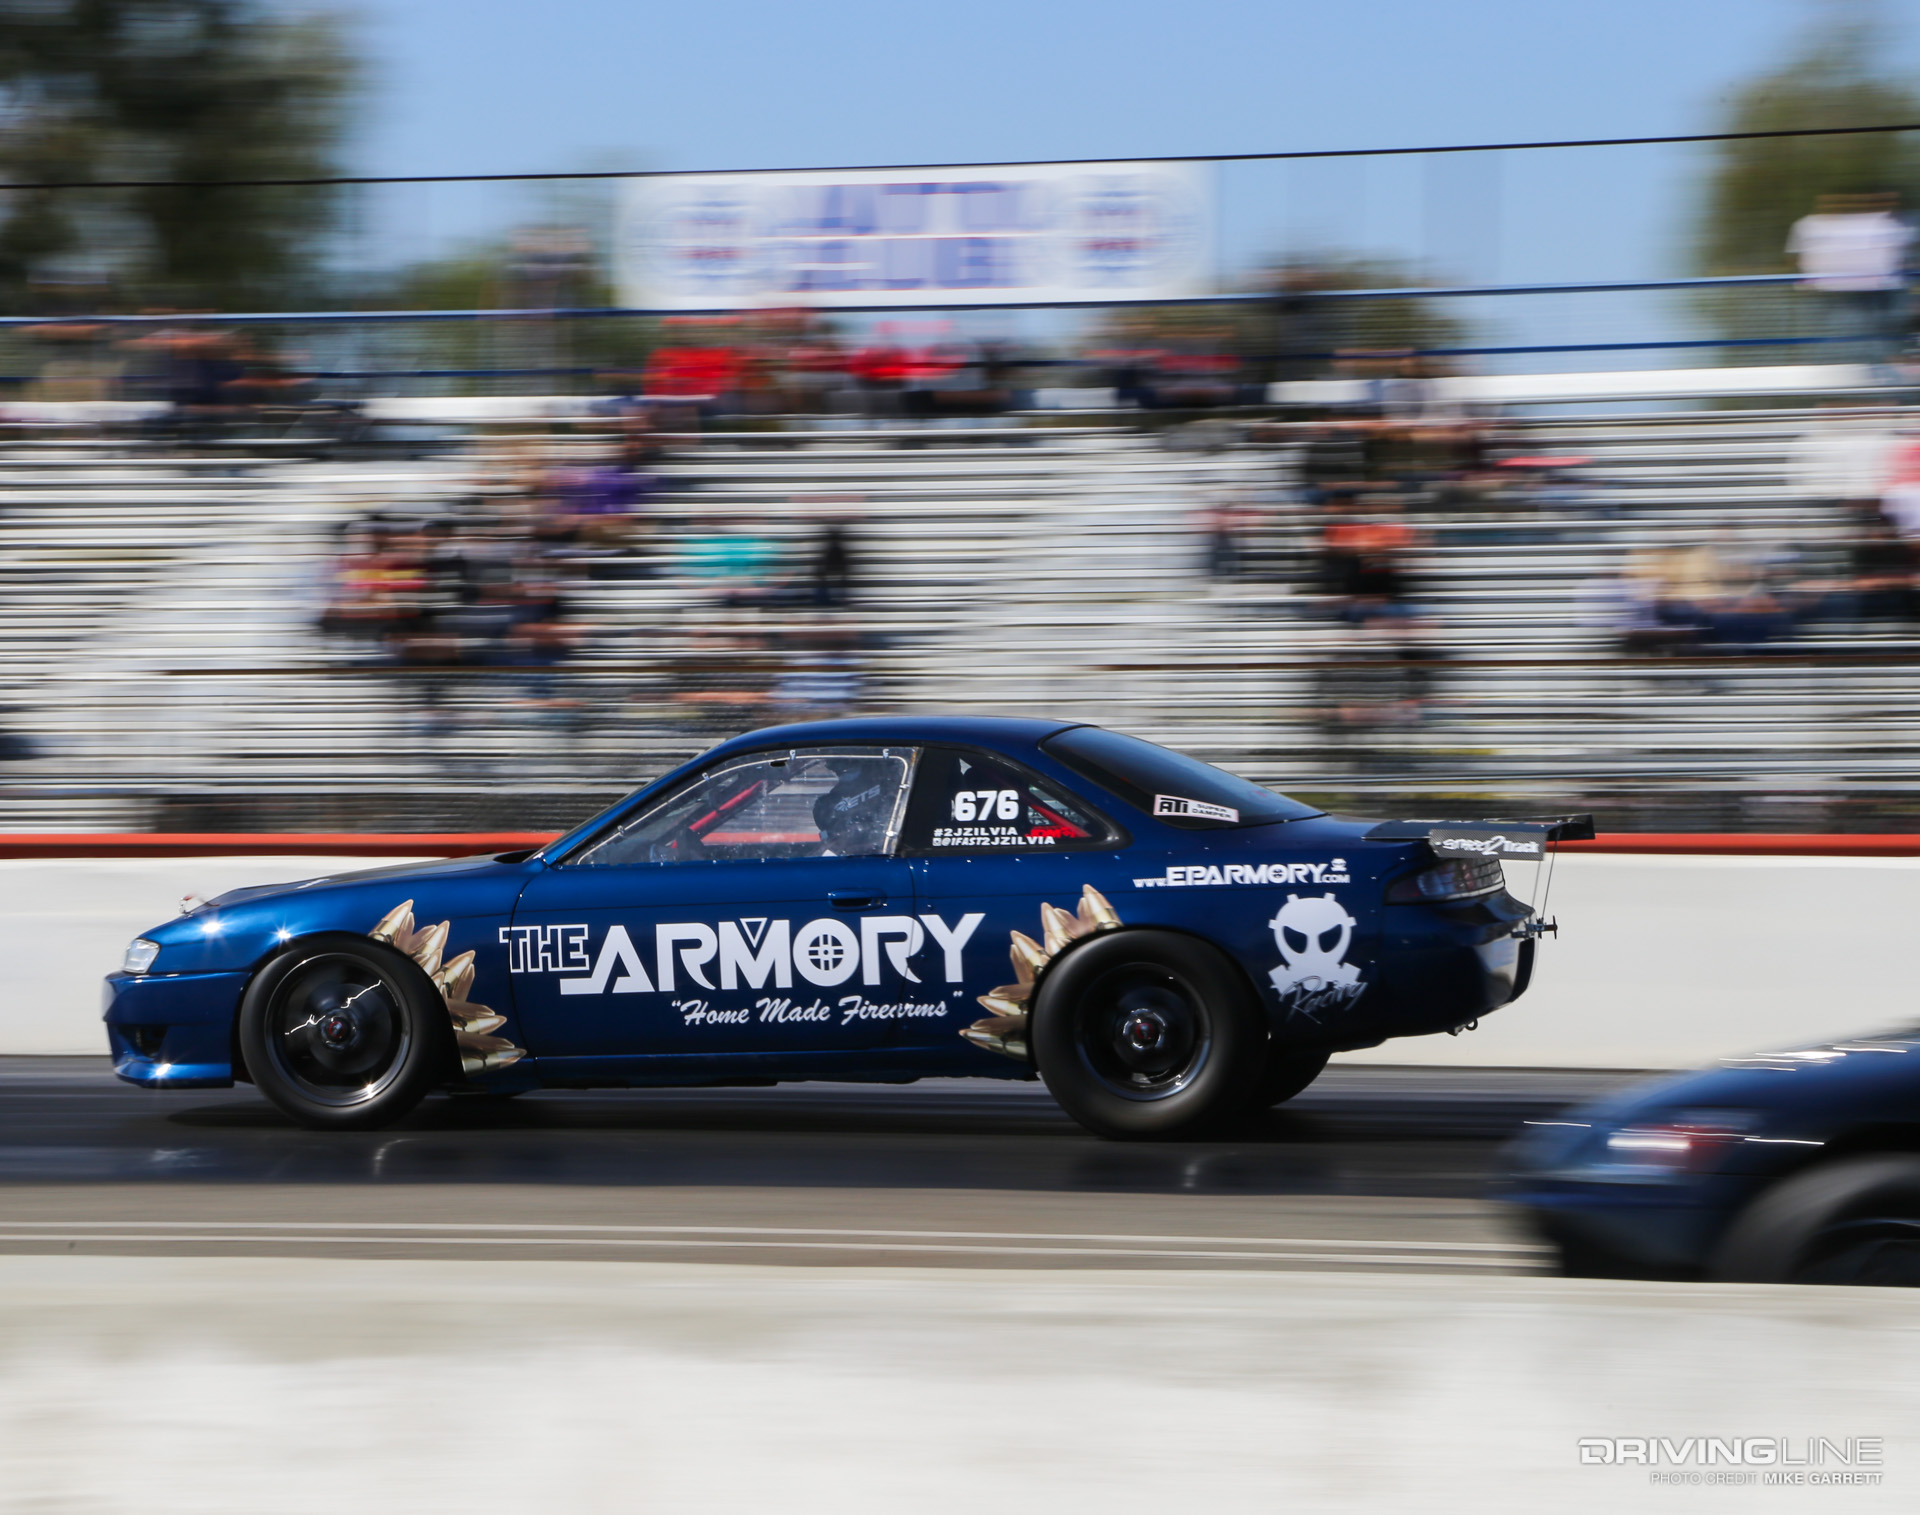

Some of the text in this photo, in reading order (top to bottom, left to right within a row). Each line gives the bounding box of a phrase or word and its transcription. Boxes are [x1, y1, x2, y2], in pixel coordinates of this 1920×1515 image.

[955, 790, 1019, 821] 676
[1192, 809, 1232, 818] DAMPER
[933, 827, 1018, 837] #2JZILVIA
[499, 913, 986, 995] THE ARMORY
[755, 997, 830, 1023] Made
